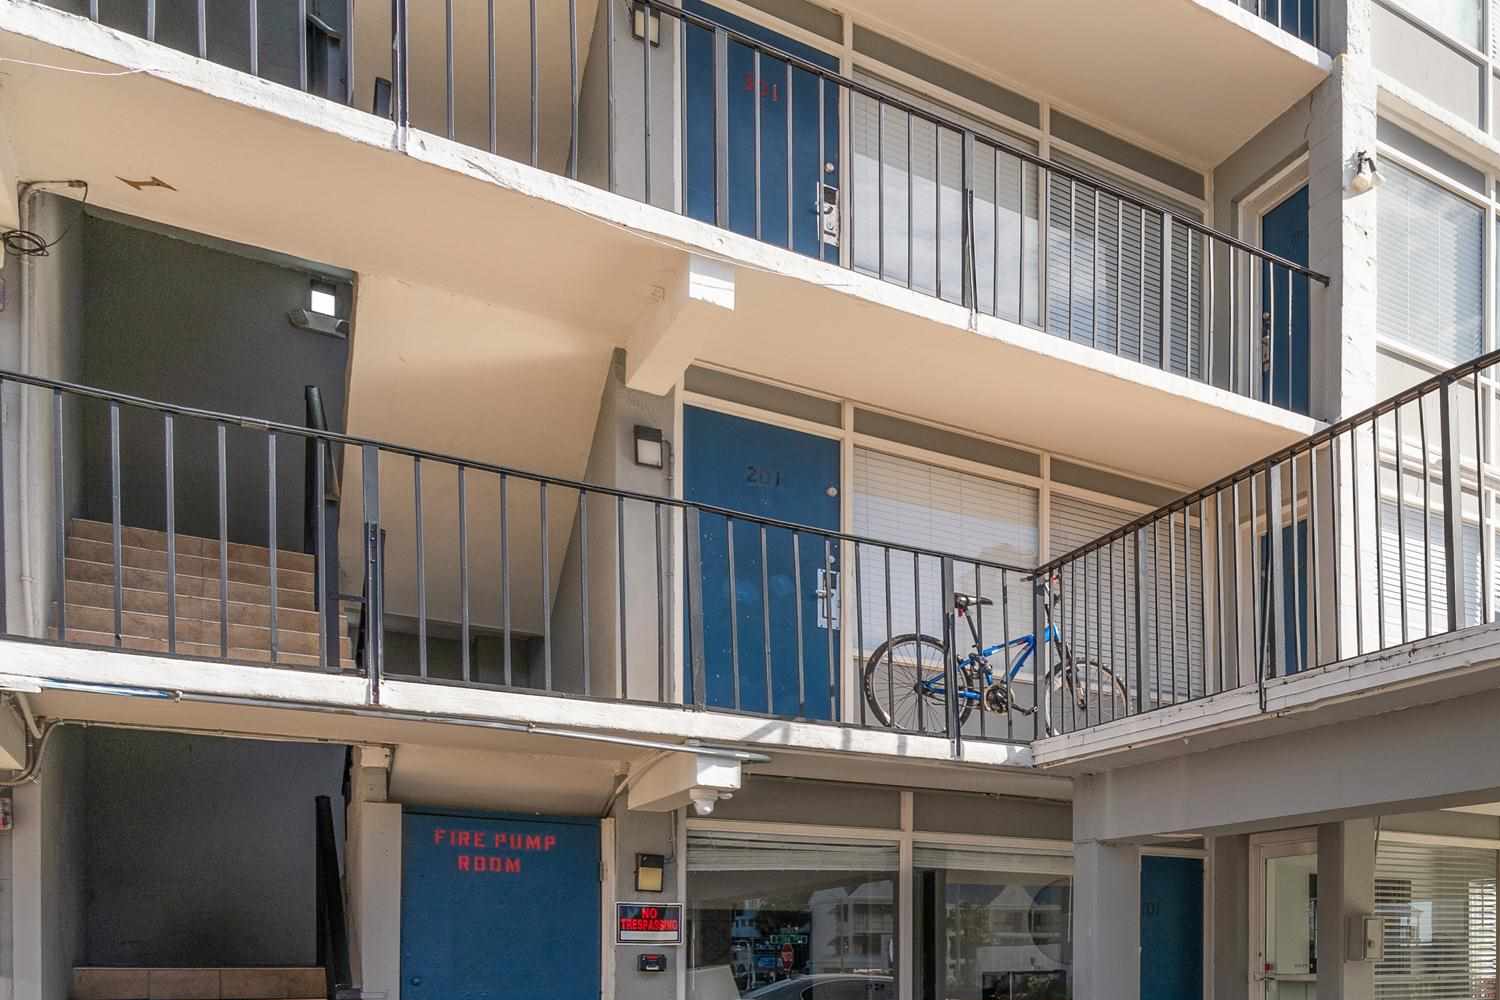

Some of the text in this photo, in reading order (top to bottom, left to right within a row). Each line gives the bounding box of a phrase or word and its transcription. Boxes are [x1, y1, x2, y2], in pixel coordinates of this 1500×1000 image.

[433, 829, 556, 850] FIRE PUMP
[458, 855, 520, 872] ROOM
[641, 908, 657, 918] NO
[621, 919, 678, 930] TRESPASSING
